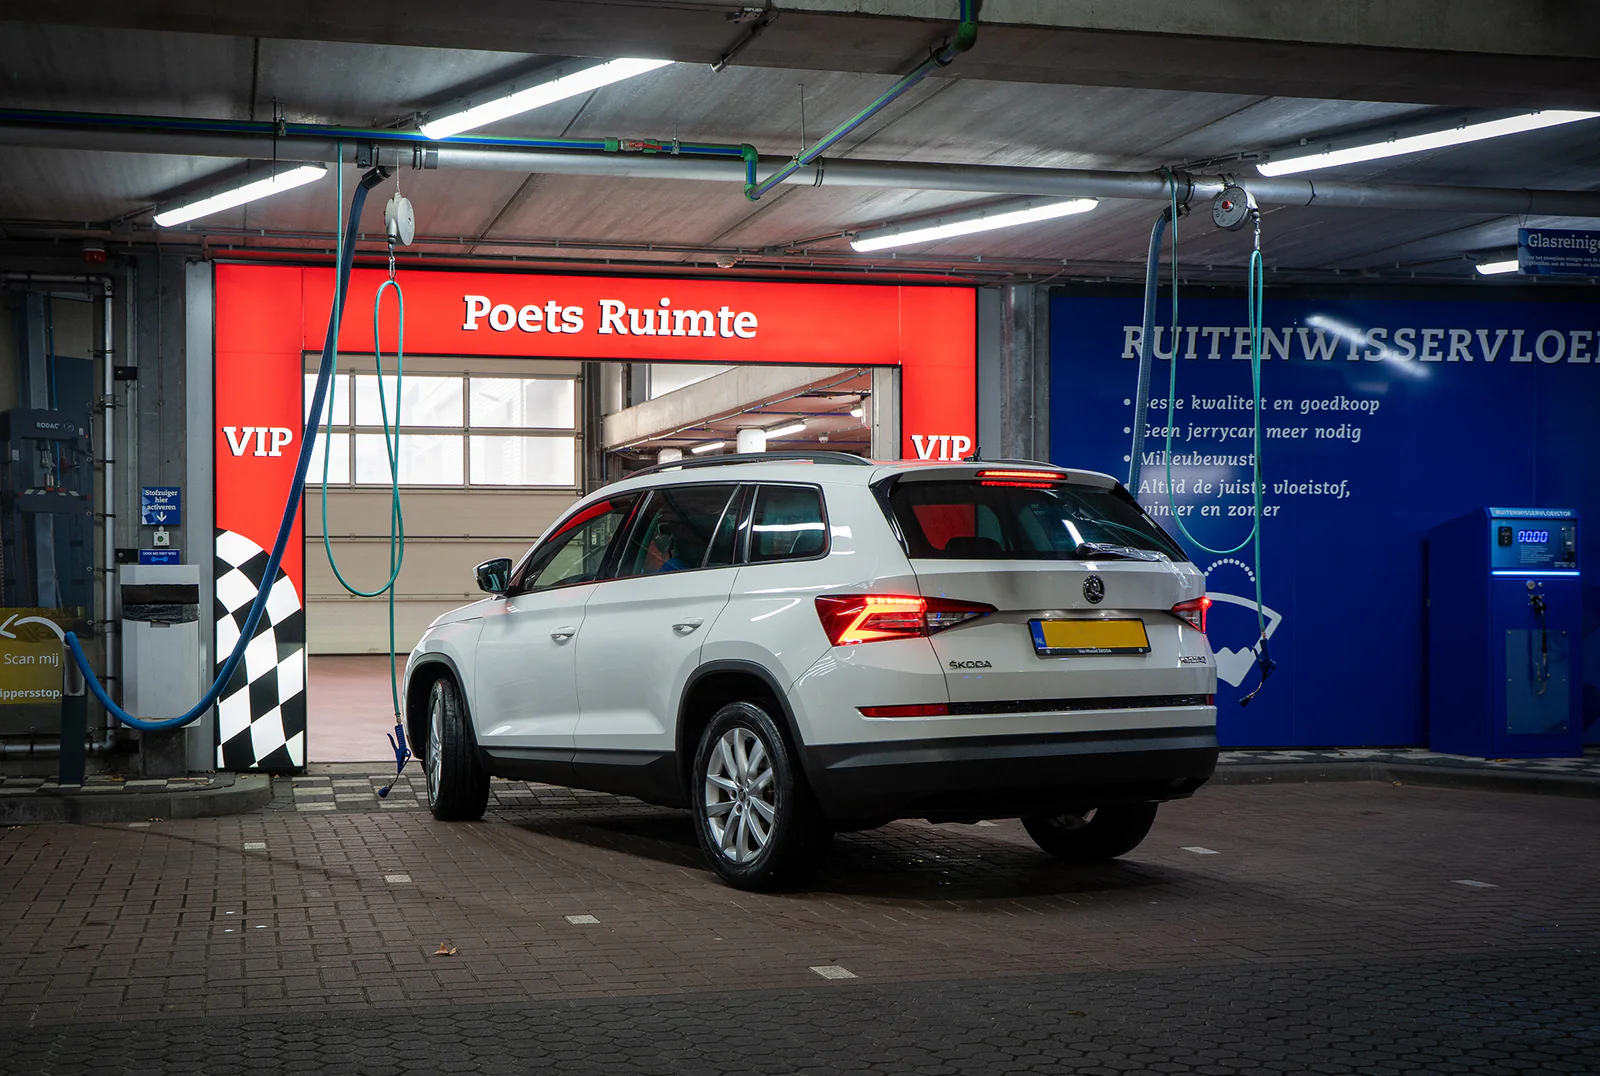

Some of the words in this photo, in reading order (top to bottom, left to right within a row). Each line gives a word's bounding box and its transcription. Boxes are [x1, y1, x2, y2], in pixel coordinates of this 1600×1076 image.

[462, 294, 584, 334] Poets
[597, 297, 759, 339] Ruimte
[1191, 395, 1267, 410] kwalitet
[1274, 399, 1294, 410] en
[1300, 395, 1380, 415] goedkoop
[36, 421, 60, 429] RODAC
[1266, 427, 1308, 439] meer
[1315, 423, 1362, 443] nodig
[221, 426, 293, 457] VIP
[910, 434, 971, 461] VIP
[145, 489, 178, 498] Stofzuiger
[1193, 479, 1212, 494] de
[1273, 479, 1350, 499] vloeistof,
[1200, 505, 1221, 516] en
[1228, 505, 1280, 516] zoner
[4, 653, 35, 665] Scan
[39, 652, 59, 668] mij
[949, 659, 992, 670] ŠKODA
